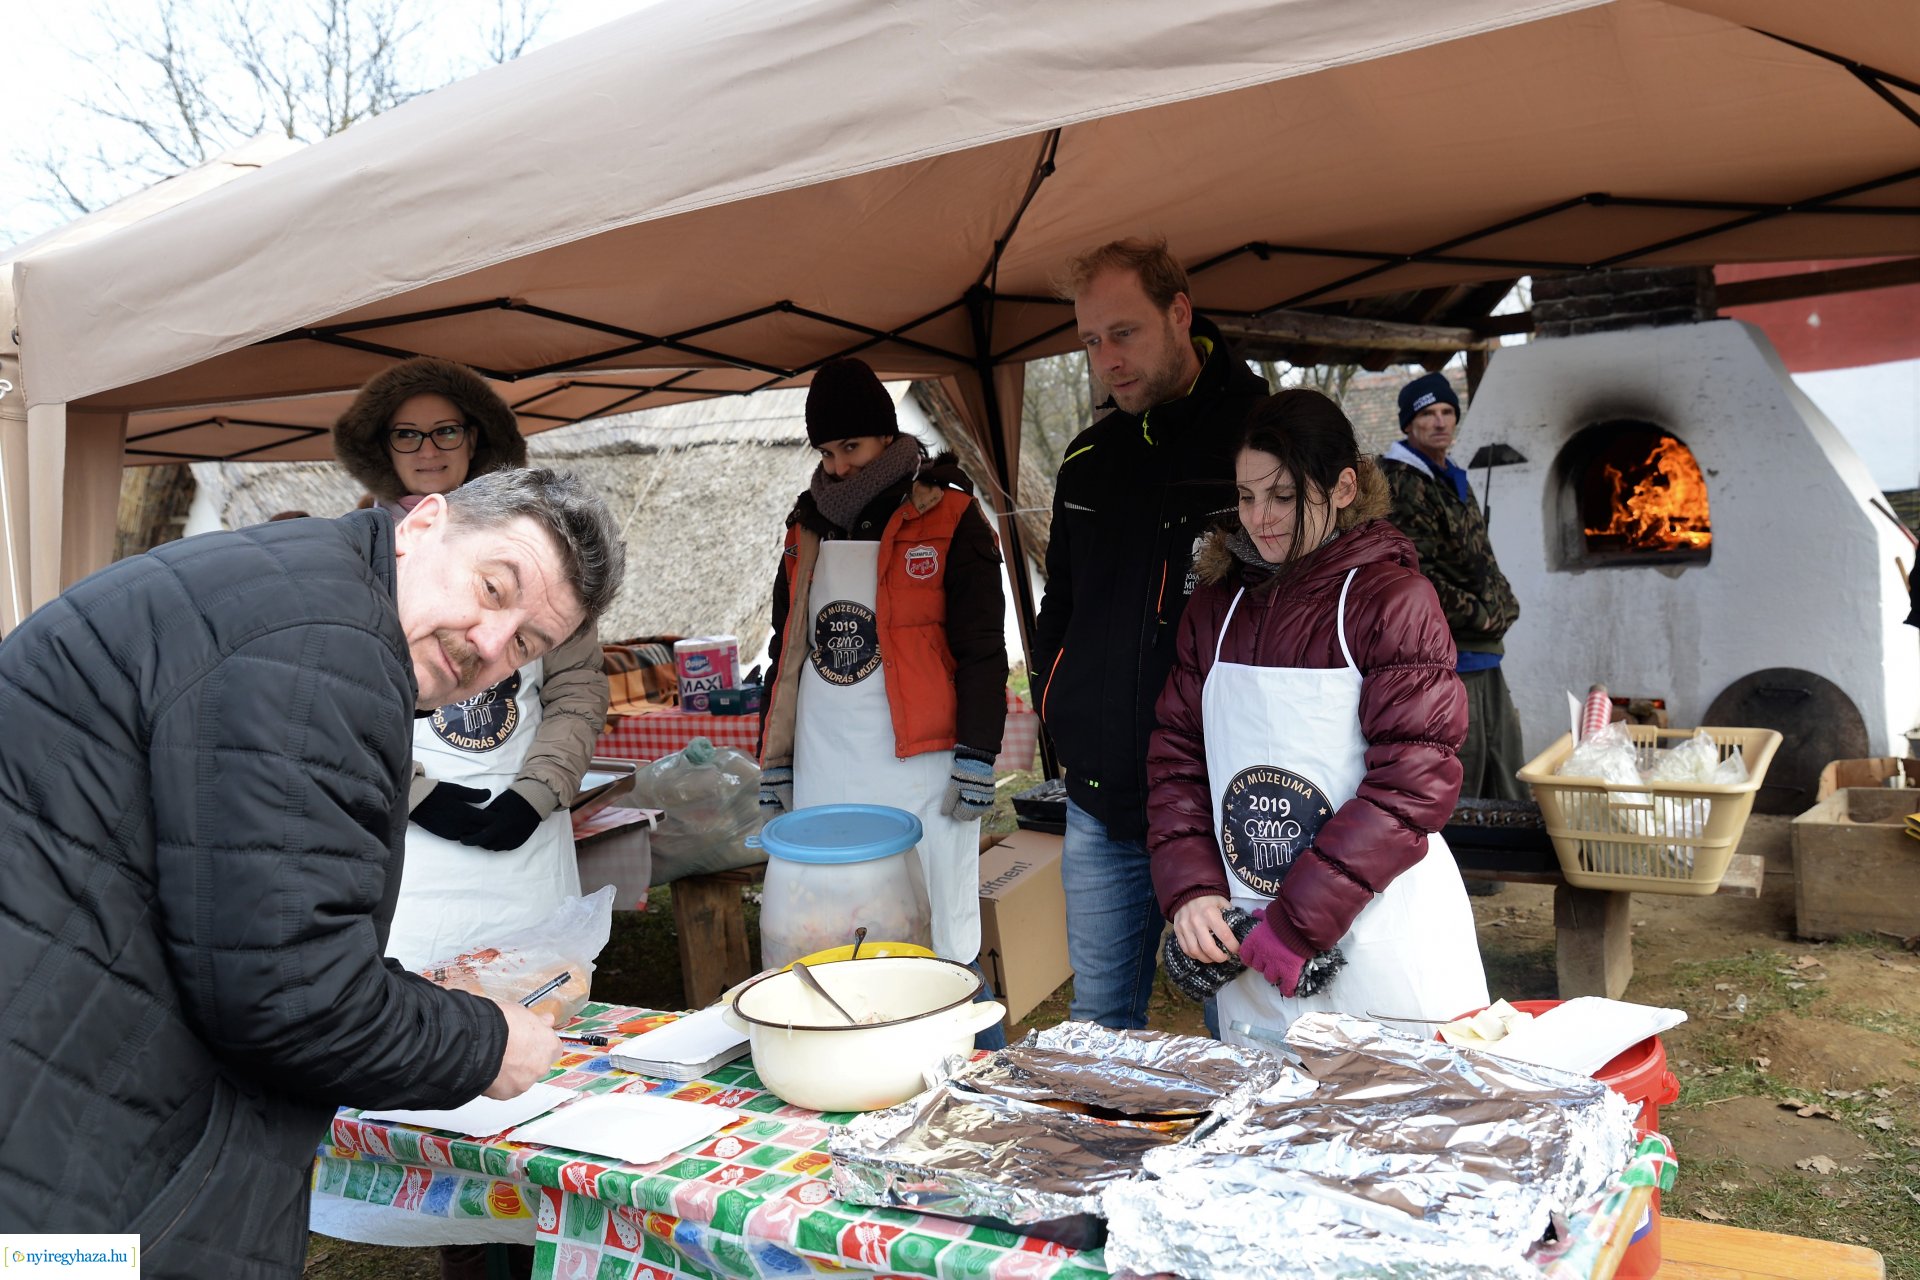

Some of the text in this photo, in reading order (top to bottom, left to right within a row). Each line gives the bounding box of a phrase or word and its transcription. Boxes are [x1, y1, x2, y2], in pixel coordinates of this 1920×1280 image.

[830, 621, 858, 634] 2019
[682, 675, 723, 693] MAXI
[447, 732, 496, 749] ANDRÁS
[496, 698, 517, 741] MÚZEUM
[1232, 769, 1313, 799] ÉV MÚZEUMA
[1249, 795, 1291, 818] 2019
[1224, 824, 1281, 893] JÓSA ANDRÁ
